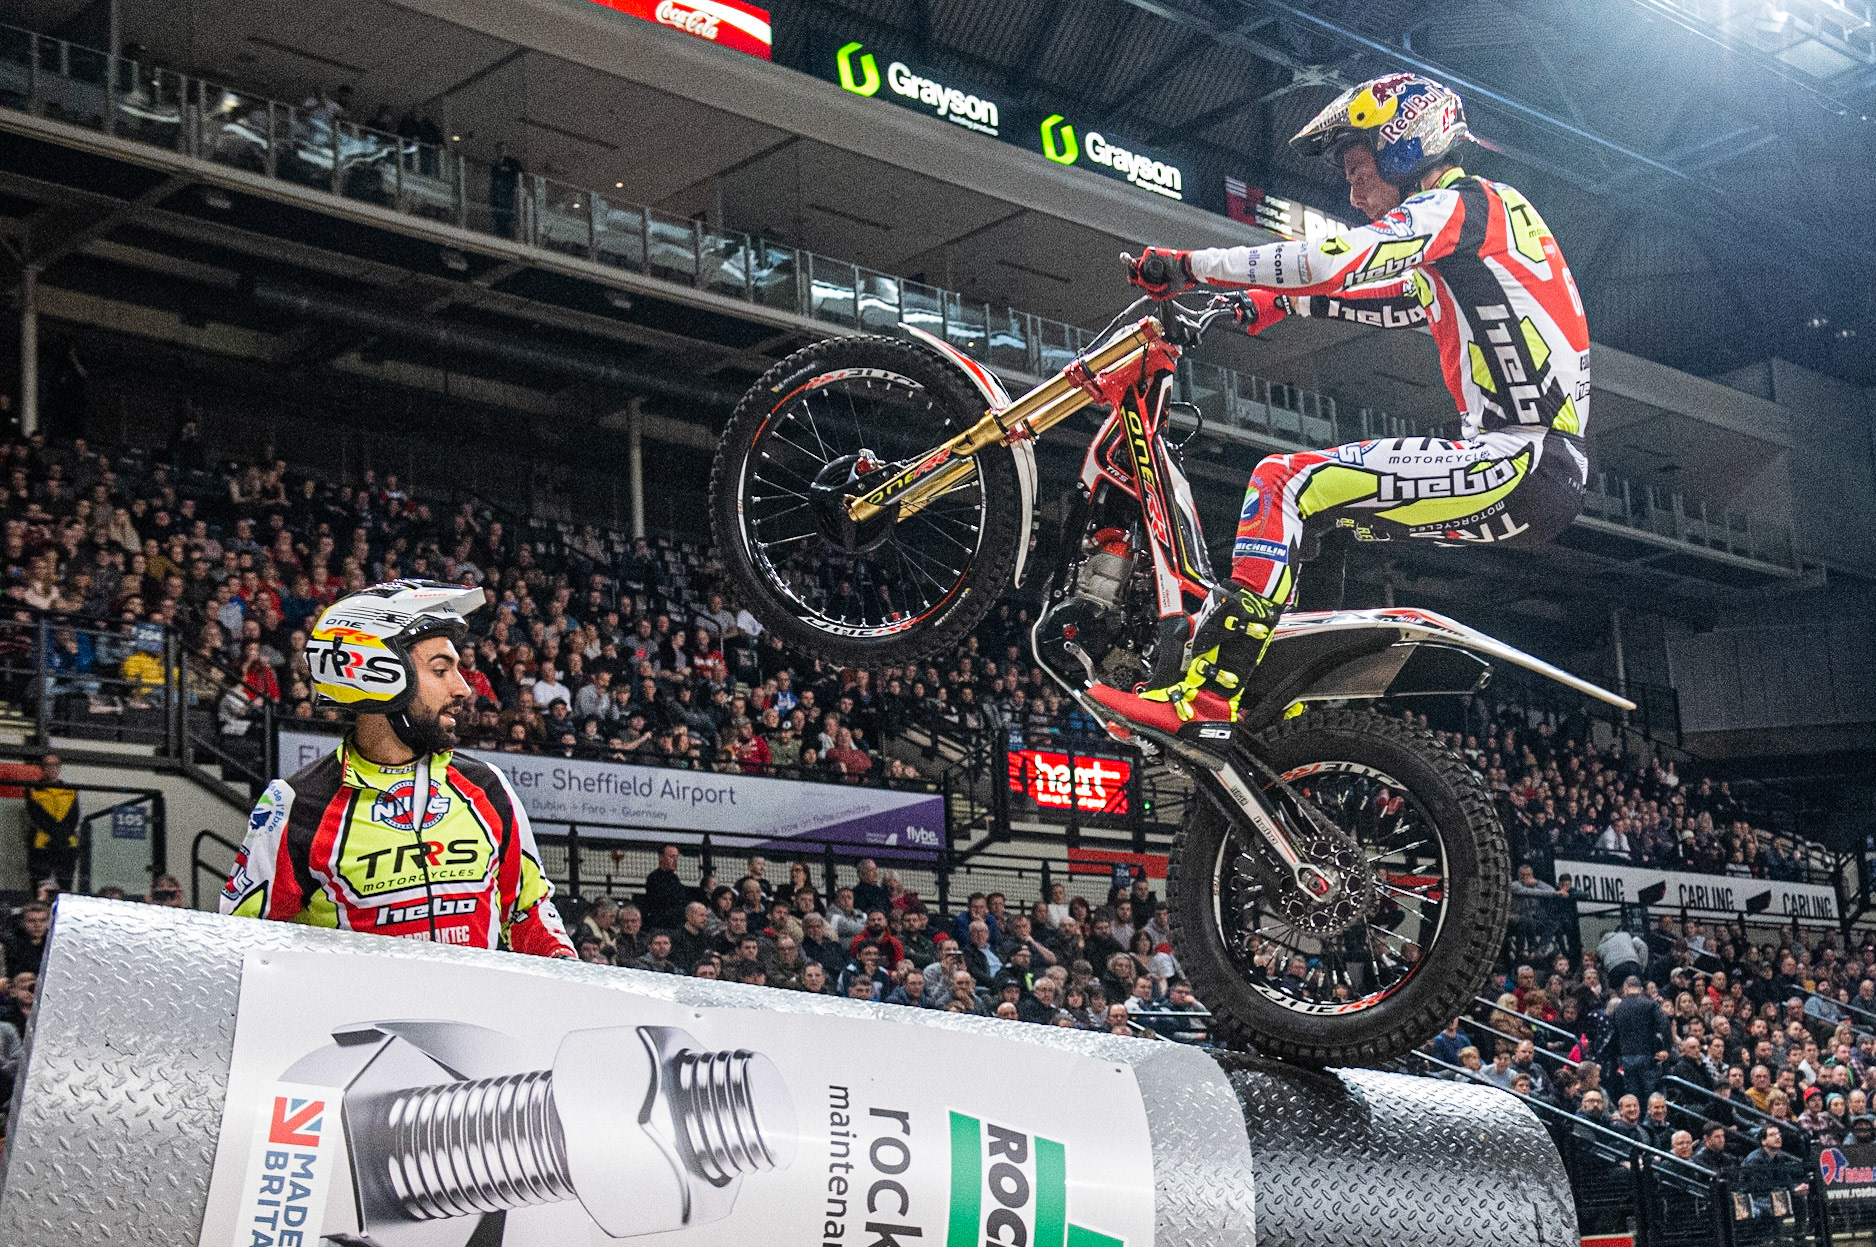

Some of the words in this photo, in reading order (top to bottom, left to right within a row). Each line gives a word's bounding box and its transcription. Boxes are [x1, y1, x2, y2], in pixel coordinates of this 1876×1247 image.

[888, 62, 999, 126] Grayson
[1379, 99, 1418, 144] Red
[1085, 132, 1182, 190] Grayson
[1343, 251, 1423, 288] hebo
[1328, 299, 1426, 329] hebo
[1475, 303, 1541, 425] heb
[1380, 458, 1517, 501] hebo
[1235, 543, 1286, 556] MICHELIN
[552, 768, 653, 798] Sheffield
[660, 778, 737, 808] Airport
[907, 826, 937, 844] flybe
[362, 868, 475, 893] MOTORCYCLES
[1575, 873, 1625, 902] ARLING
[1679, 883, 1735, 911] CARLING
[375, 896, 478, 928] hebo
[1782, 892, 1834, 919] CARLING
[822, 1084, 858, 1247] maintena
